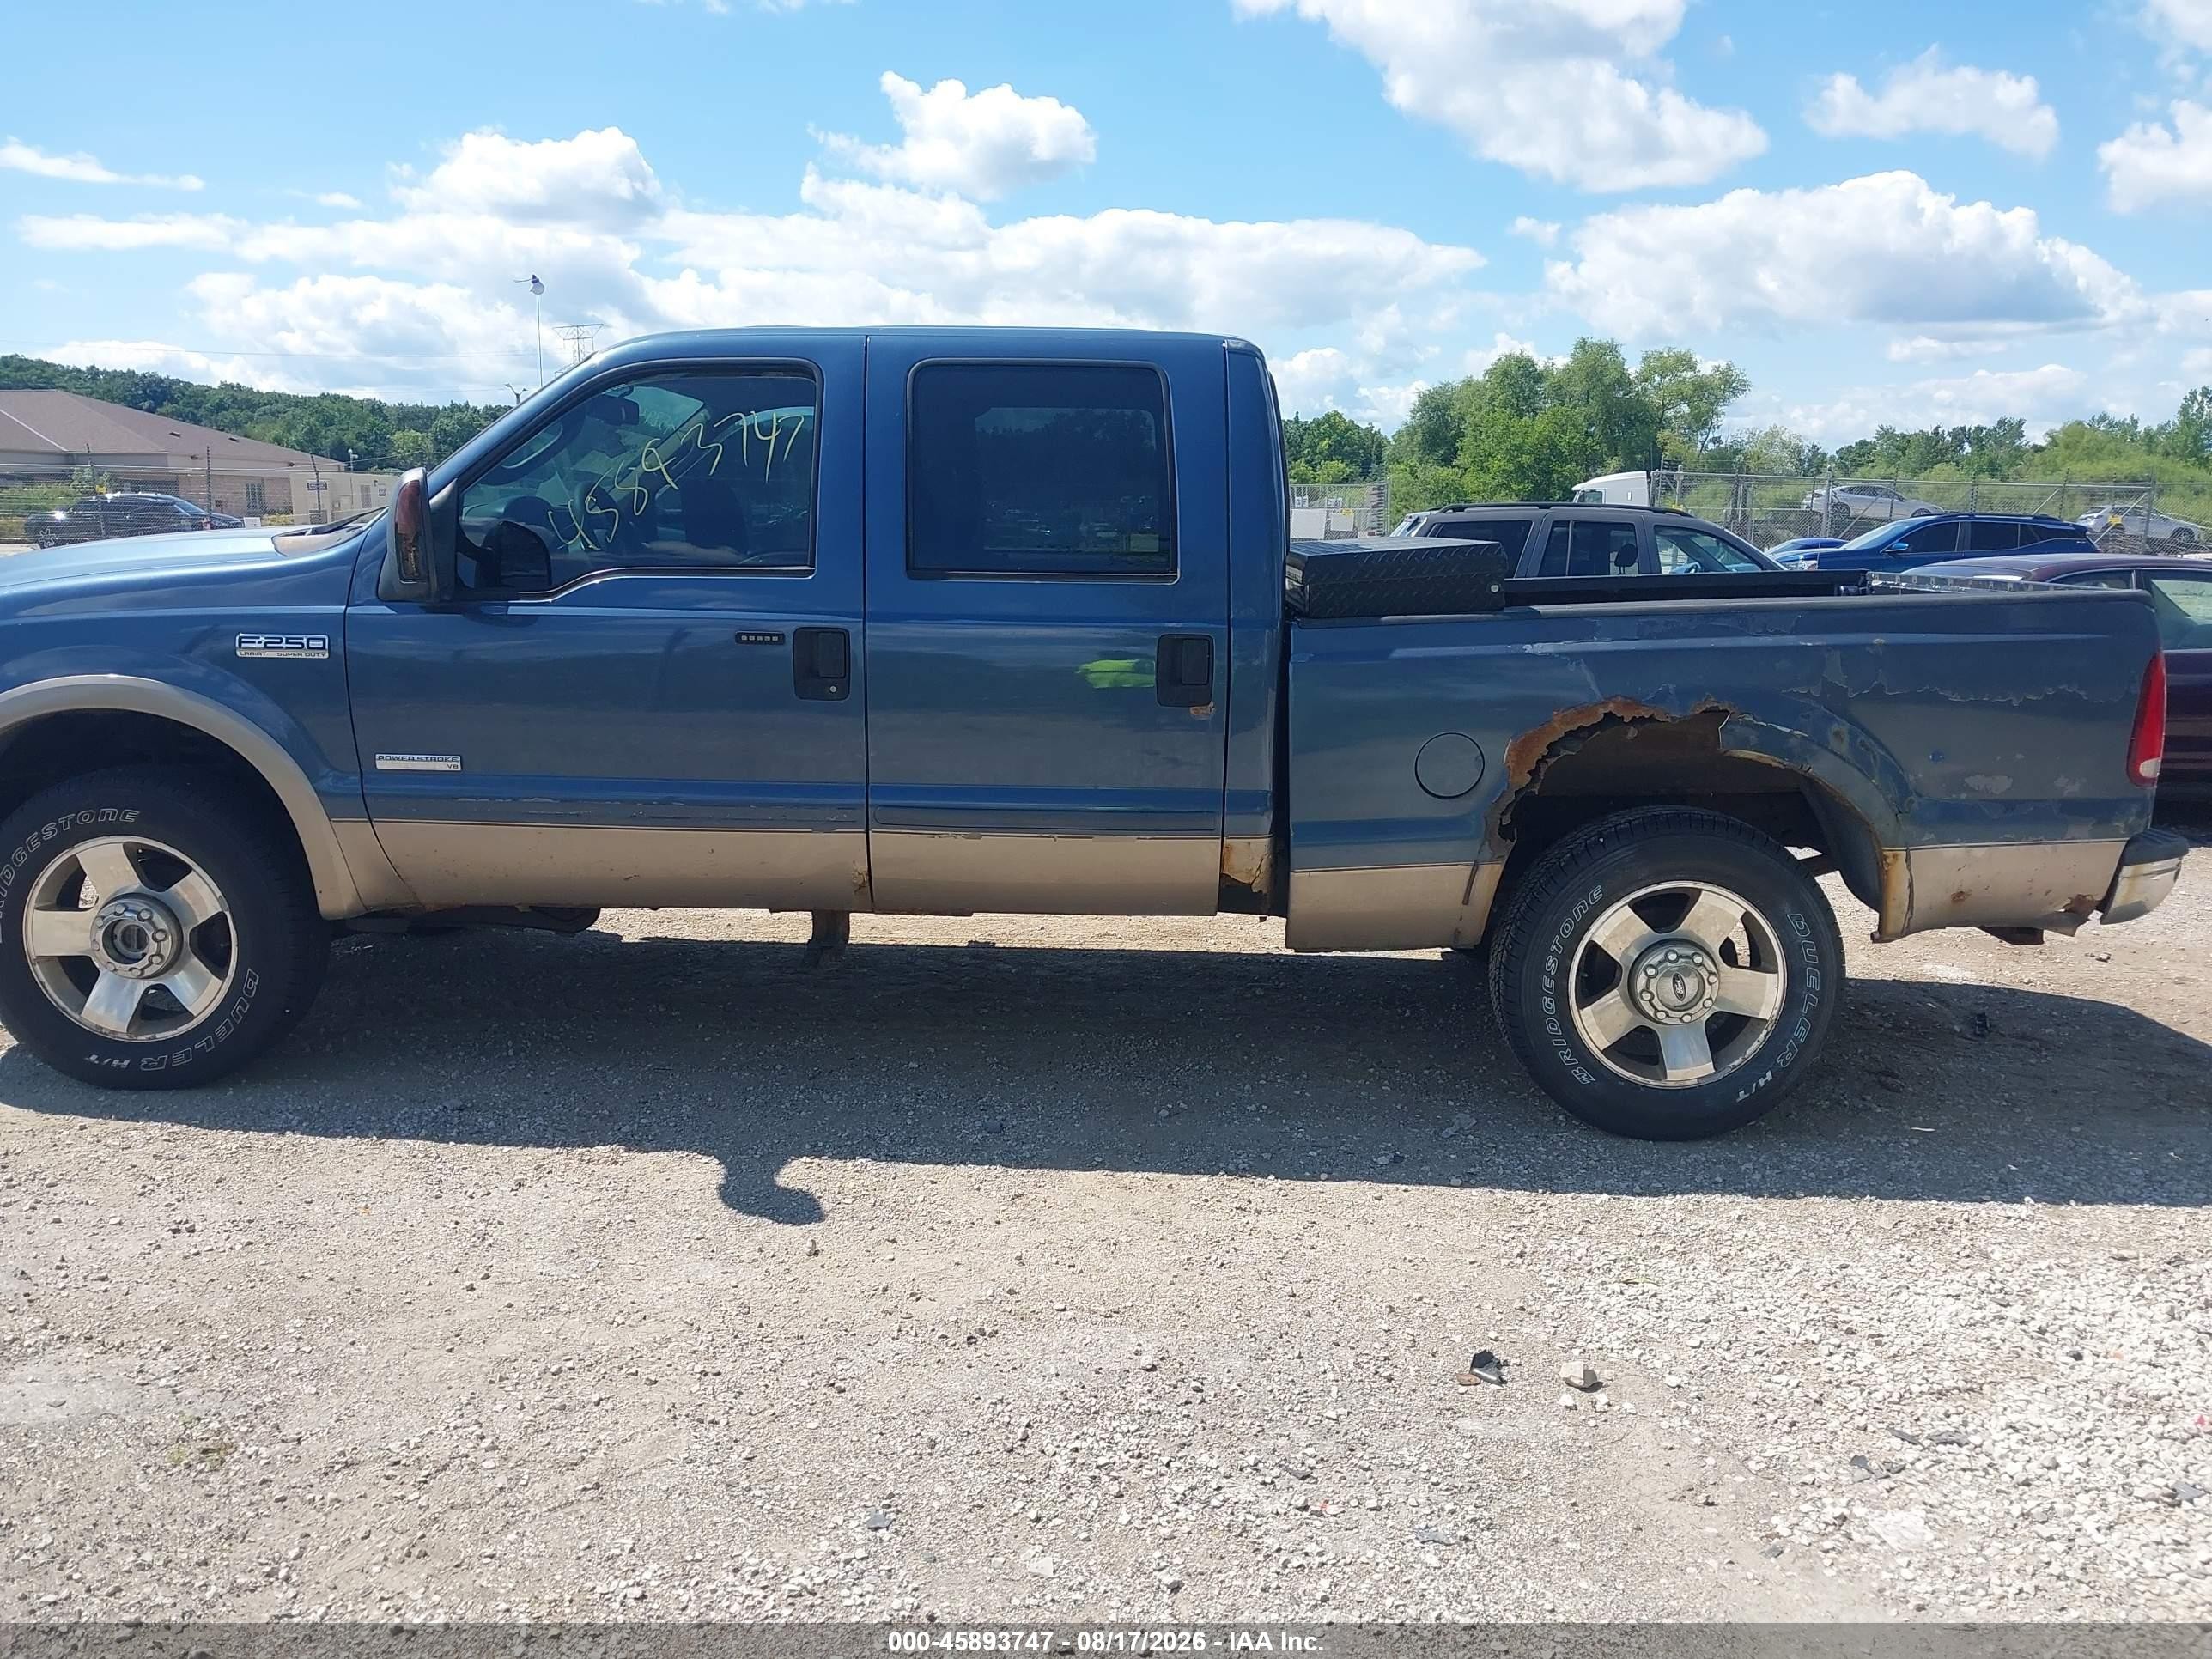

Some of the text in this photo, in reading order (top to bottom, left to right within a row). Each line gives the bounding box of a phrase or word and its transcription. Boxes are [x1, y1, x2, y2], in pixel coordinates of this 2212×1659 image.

[548, 410, 805, 551] 45893747
[140, 969, 260, 1072] DUELER
[1542, 884, 1604, 1085] BRIDGESTONE
[1777, 912, 1820, 1068] DUELER
